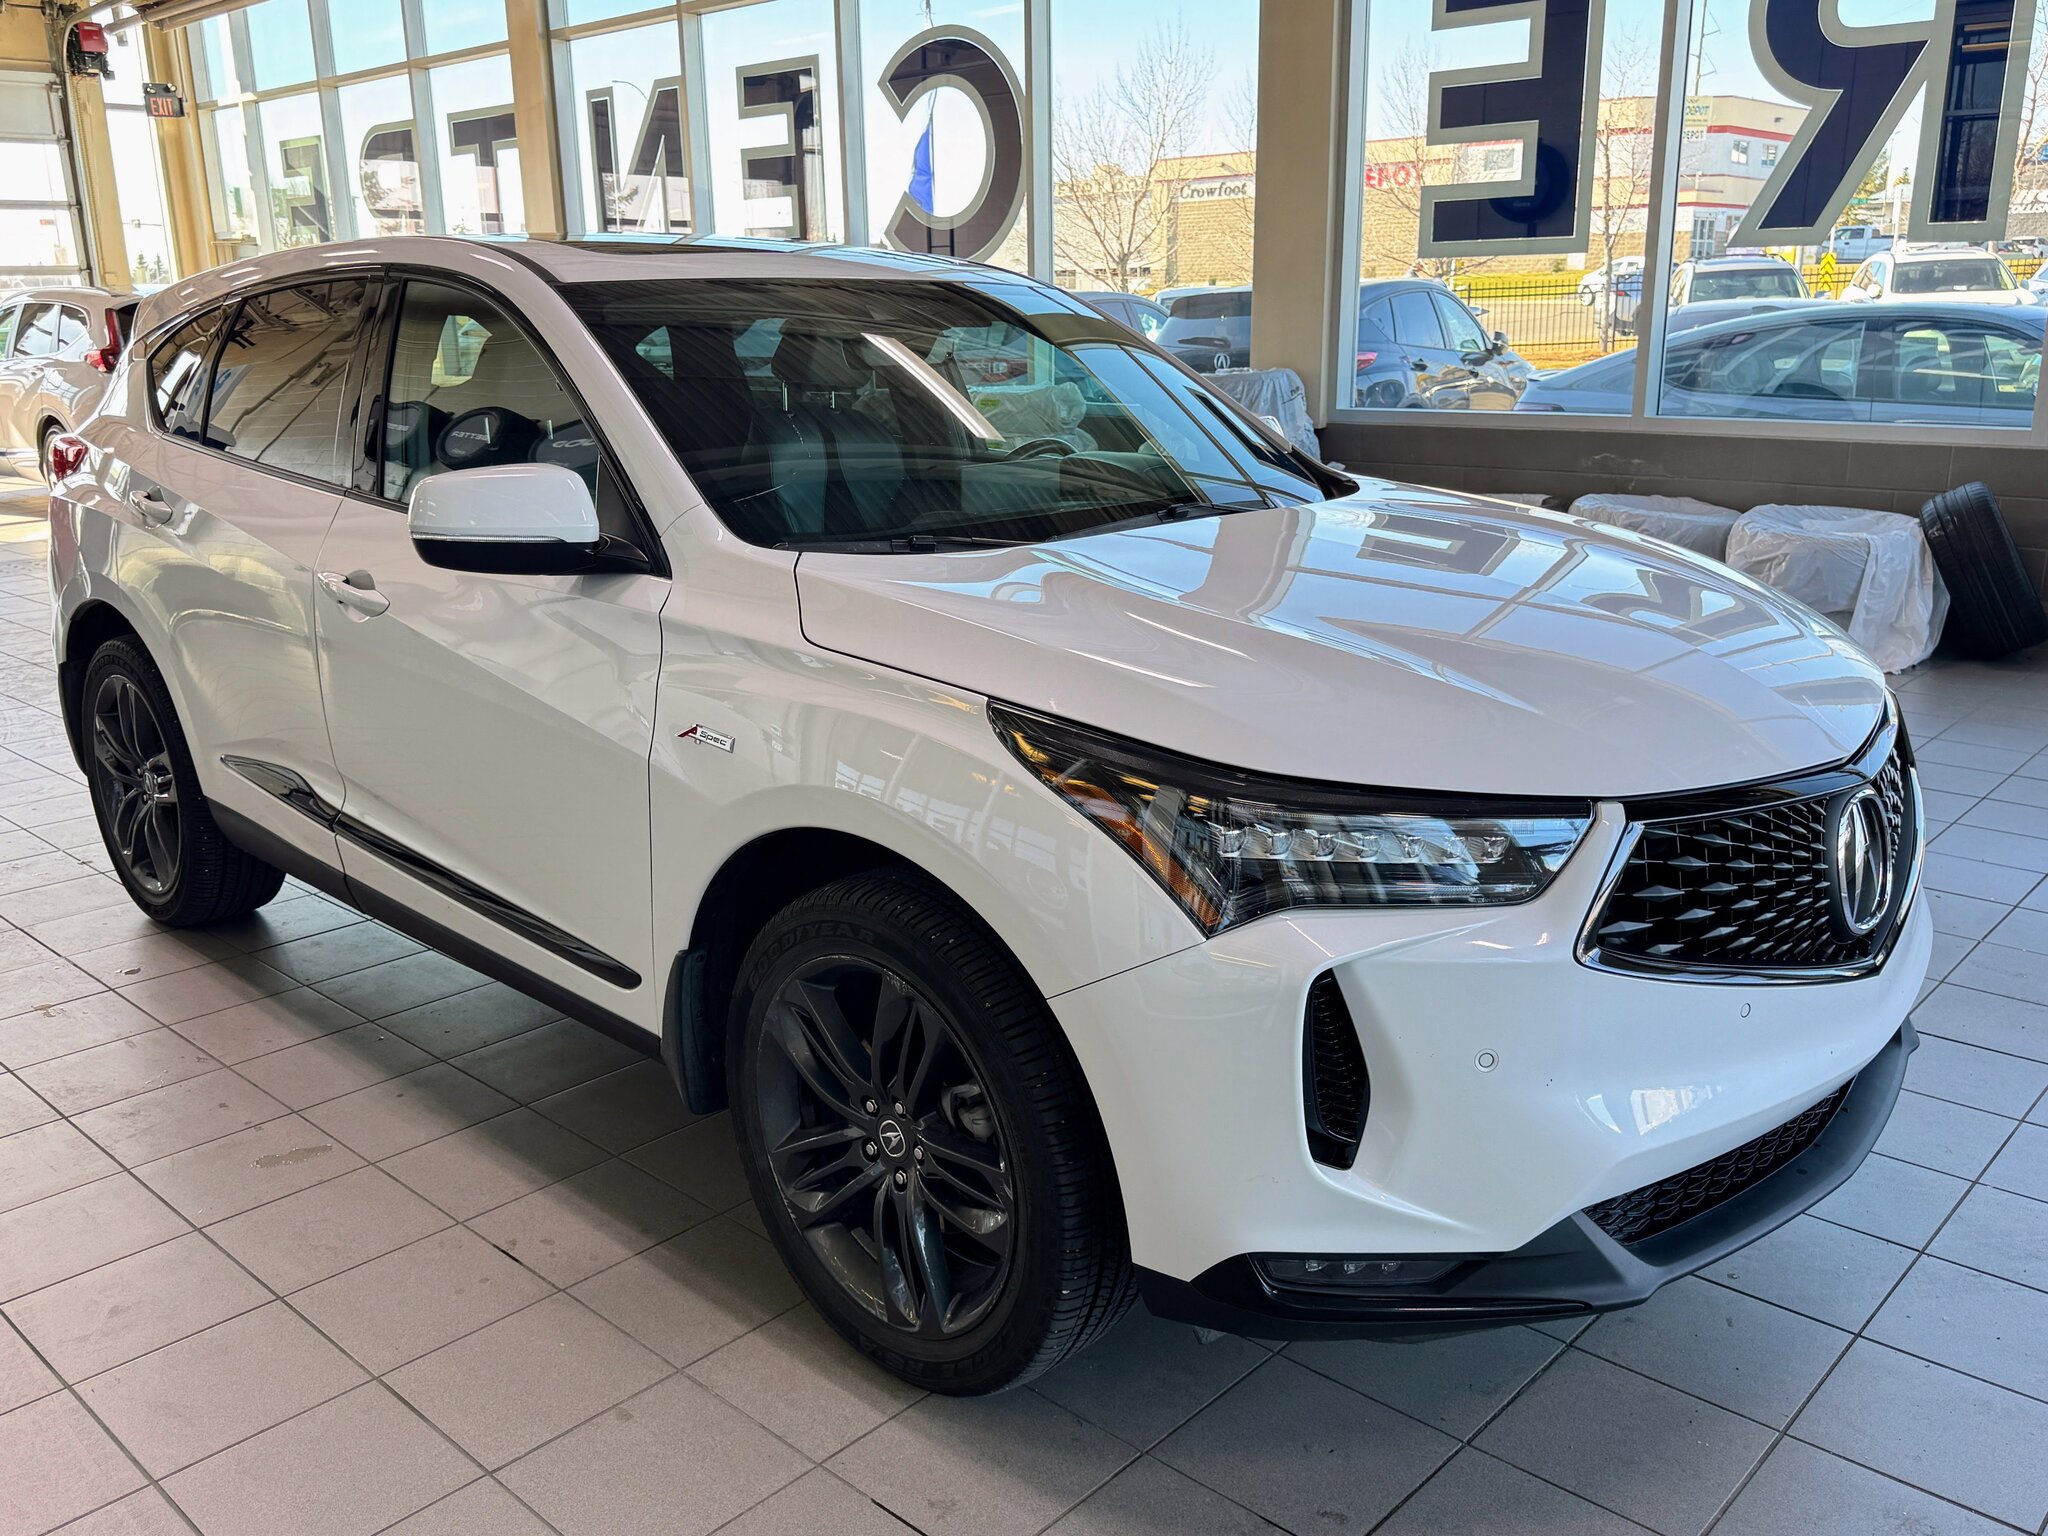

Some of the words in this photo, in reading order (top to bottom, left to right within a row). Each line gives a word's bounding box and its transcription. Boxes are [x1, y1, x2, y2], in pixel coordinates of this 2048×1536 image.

[150, 97, 174, 116] EXIT
[1180, 181, 1247, 199] Crowfoot
[699, 730, 728, 747] Spec
